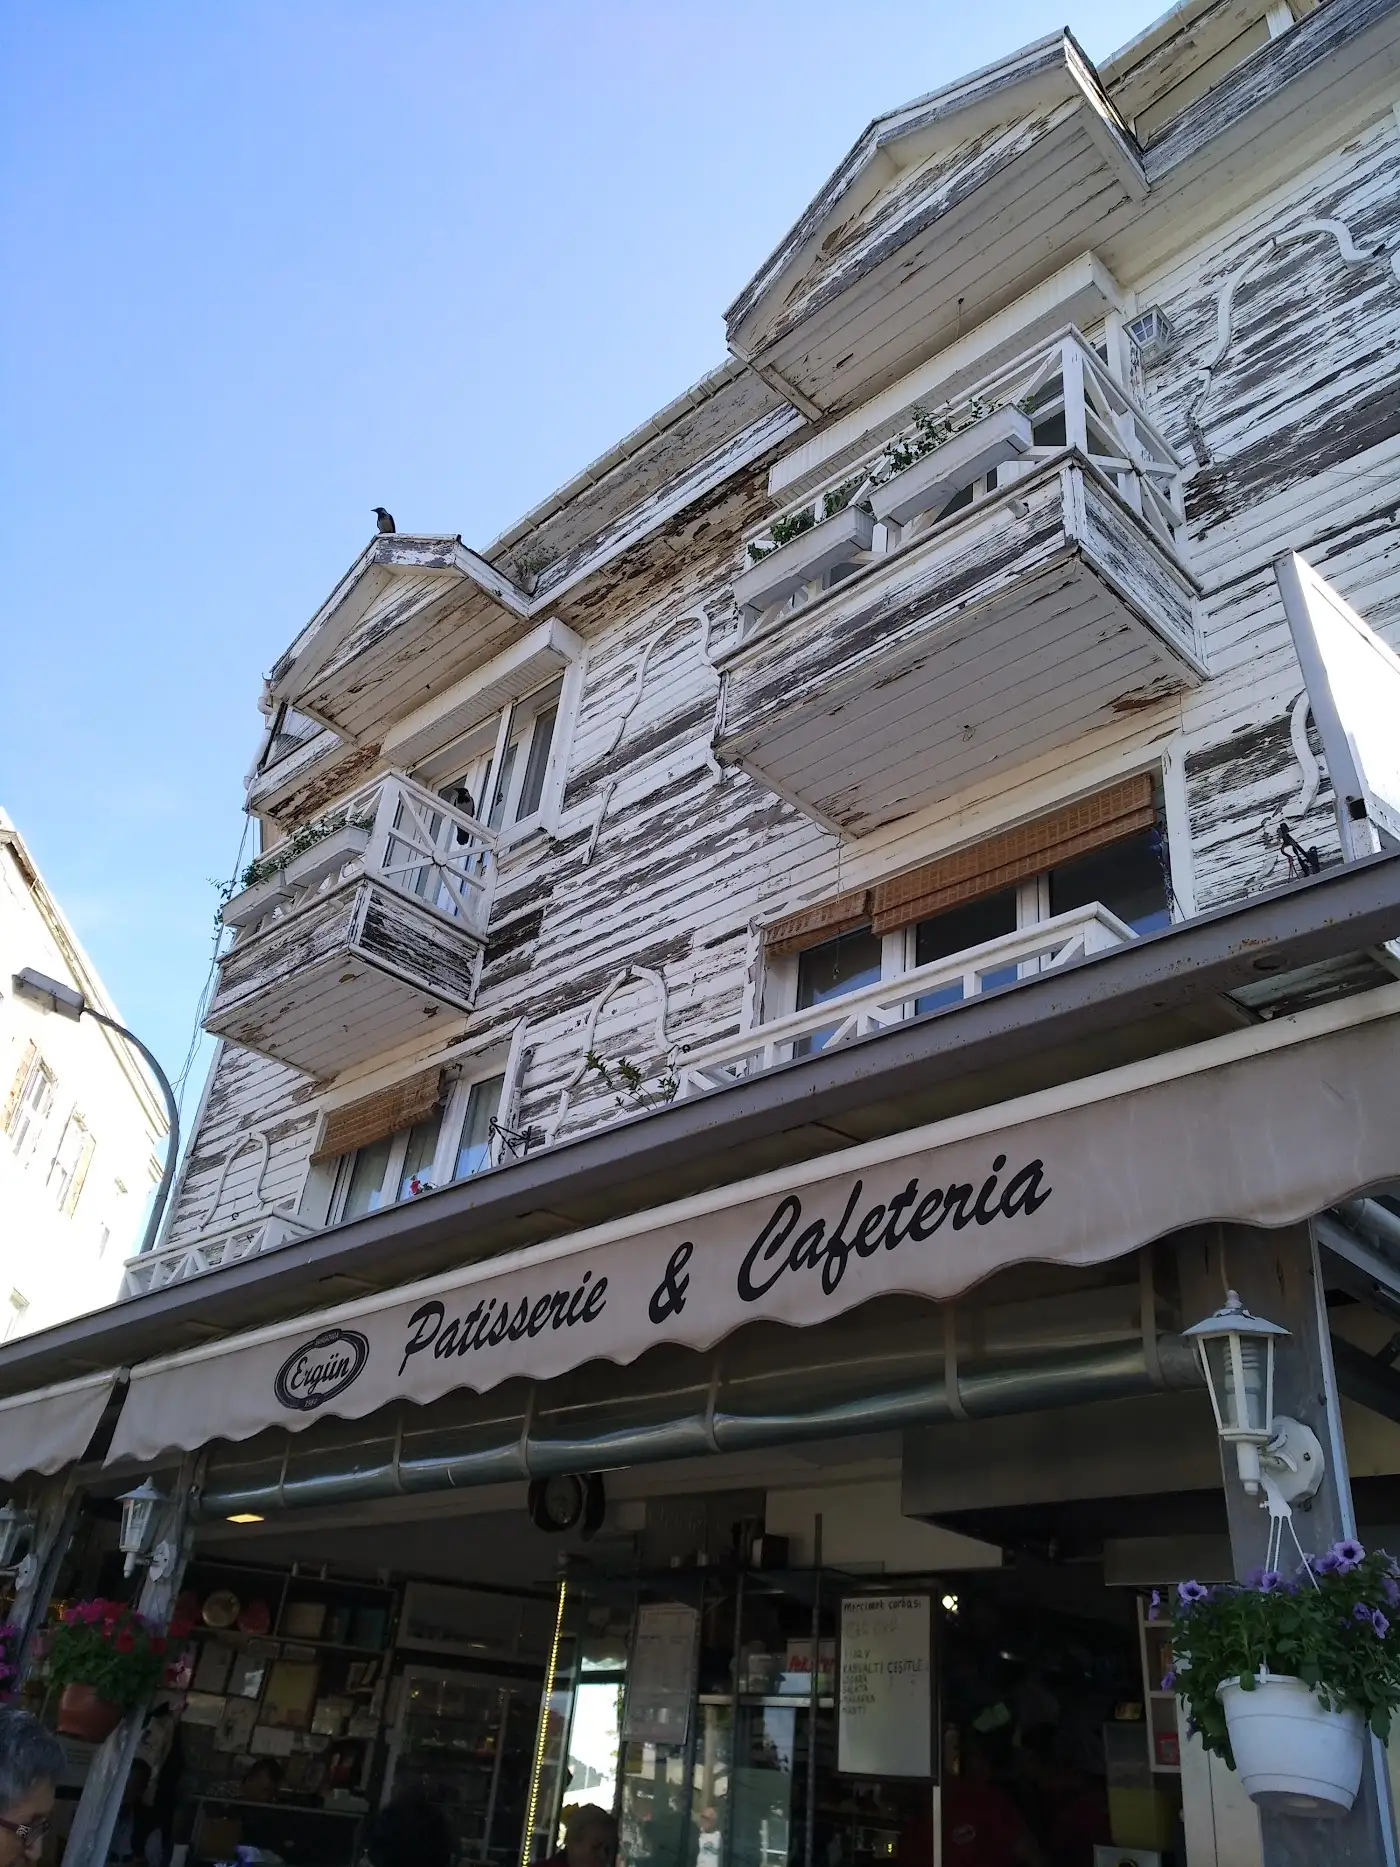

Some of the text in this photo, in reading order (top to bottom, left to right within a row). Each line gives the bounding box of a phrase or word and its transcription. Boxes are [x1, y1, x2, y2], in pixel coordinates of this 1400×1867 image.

[397, 1153, 1053, 1378] Patisserie & Cafeteria
[290, 1352, 350, 1395] Ergün
